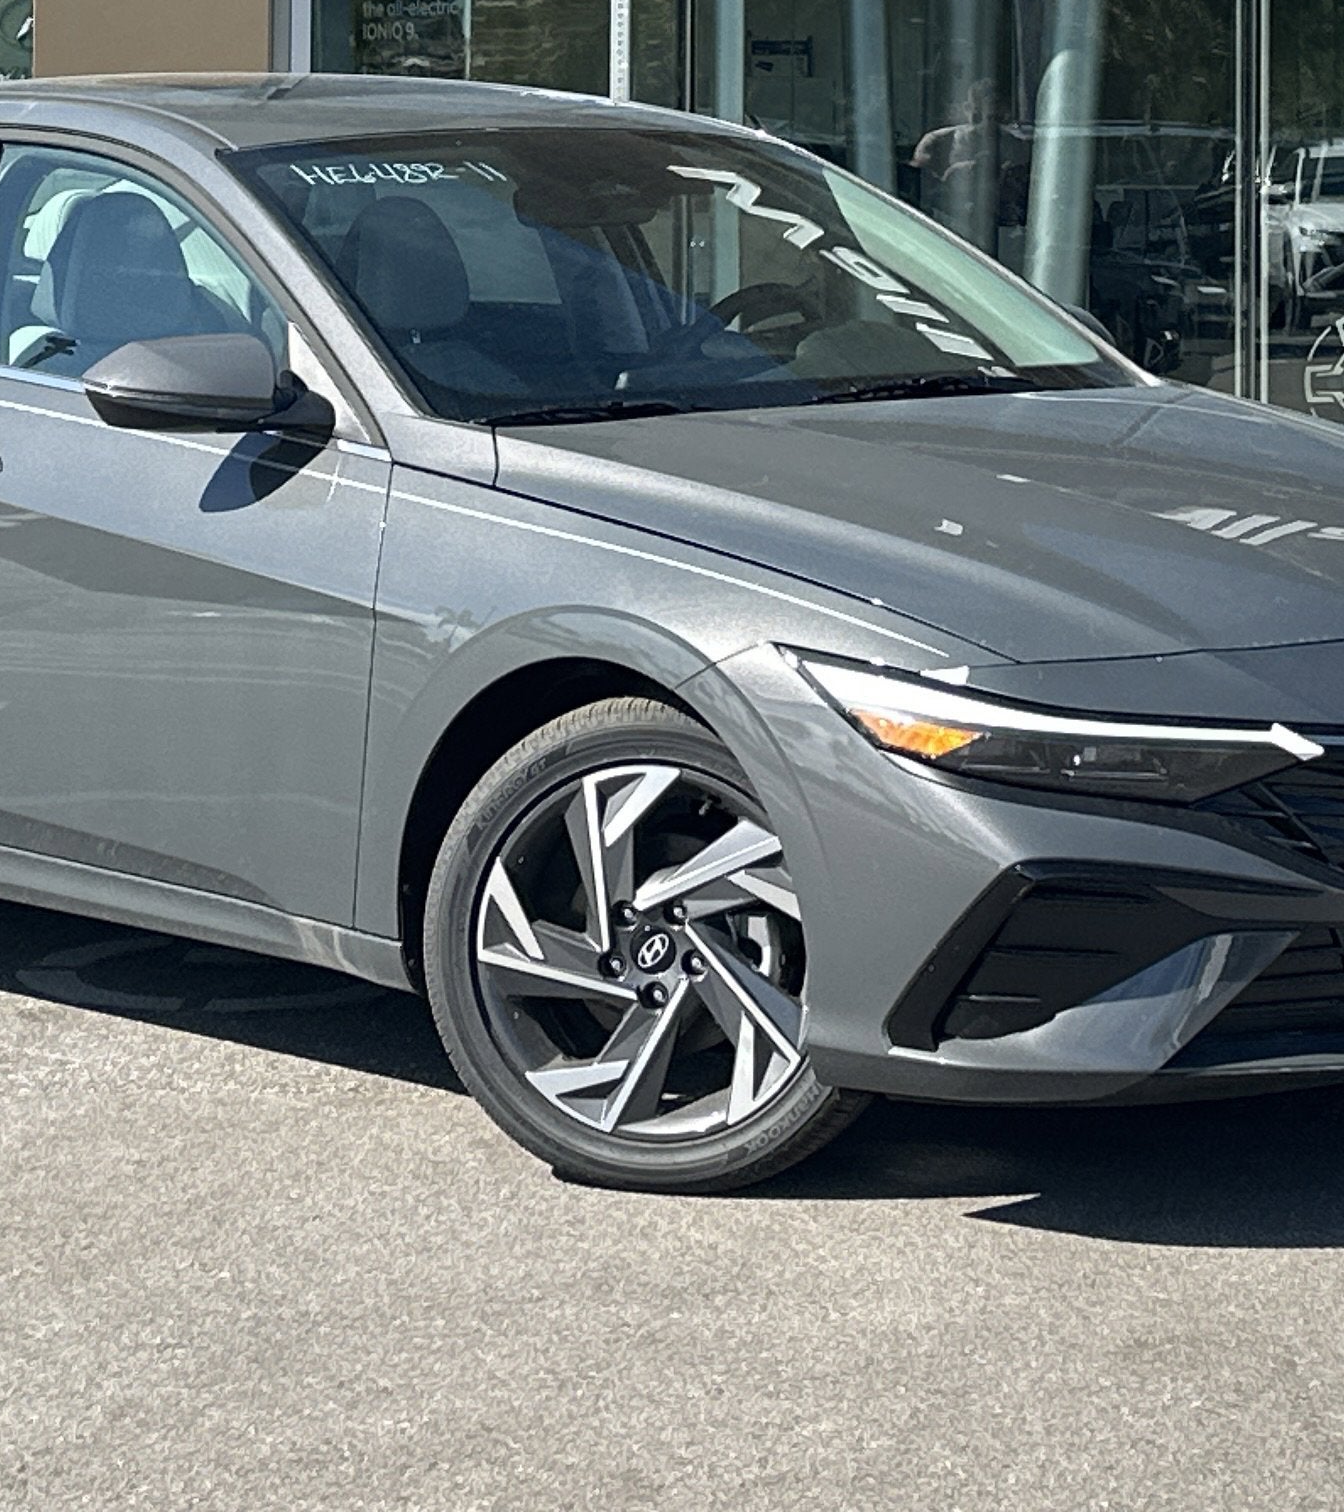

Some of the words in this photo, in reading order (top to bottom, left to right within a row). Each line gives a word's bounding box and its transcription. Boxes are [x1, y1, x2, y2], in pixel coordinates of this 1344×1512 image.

[362, 0, 385, 18] the
[387, 0, 459, 16] all-electric
[362, 21, 403, 43] IONIQ
